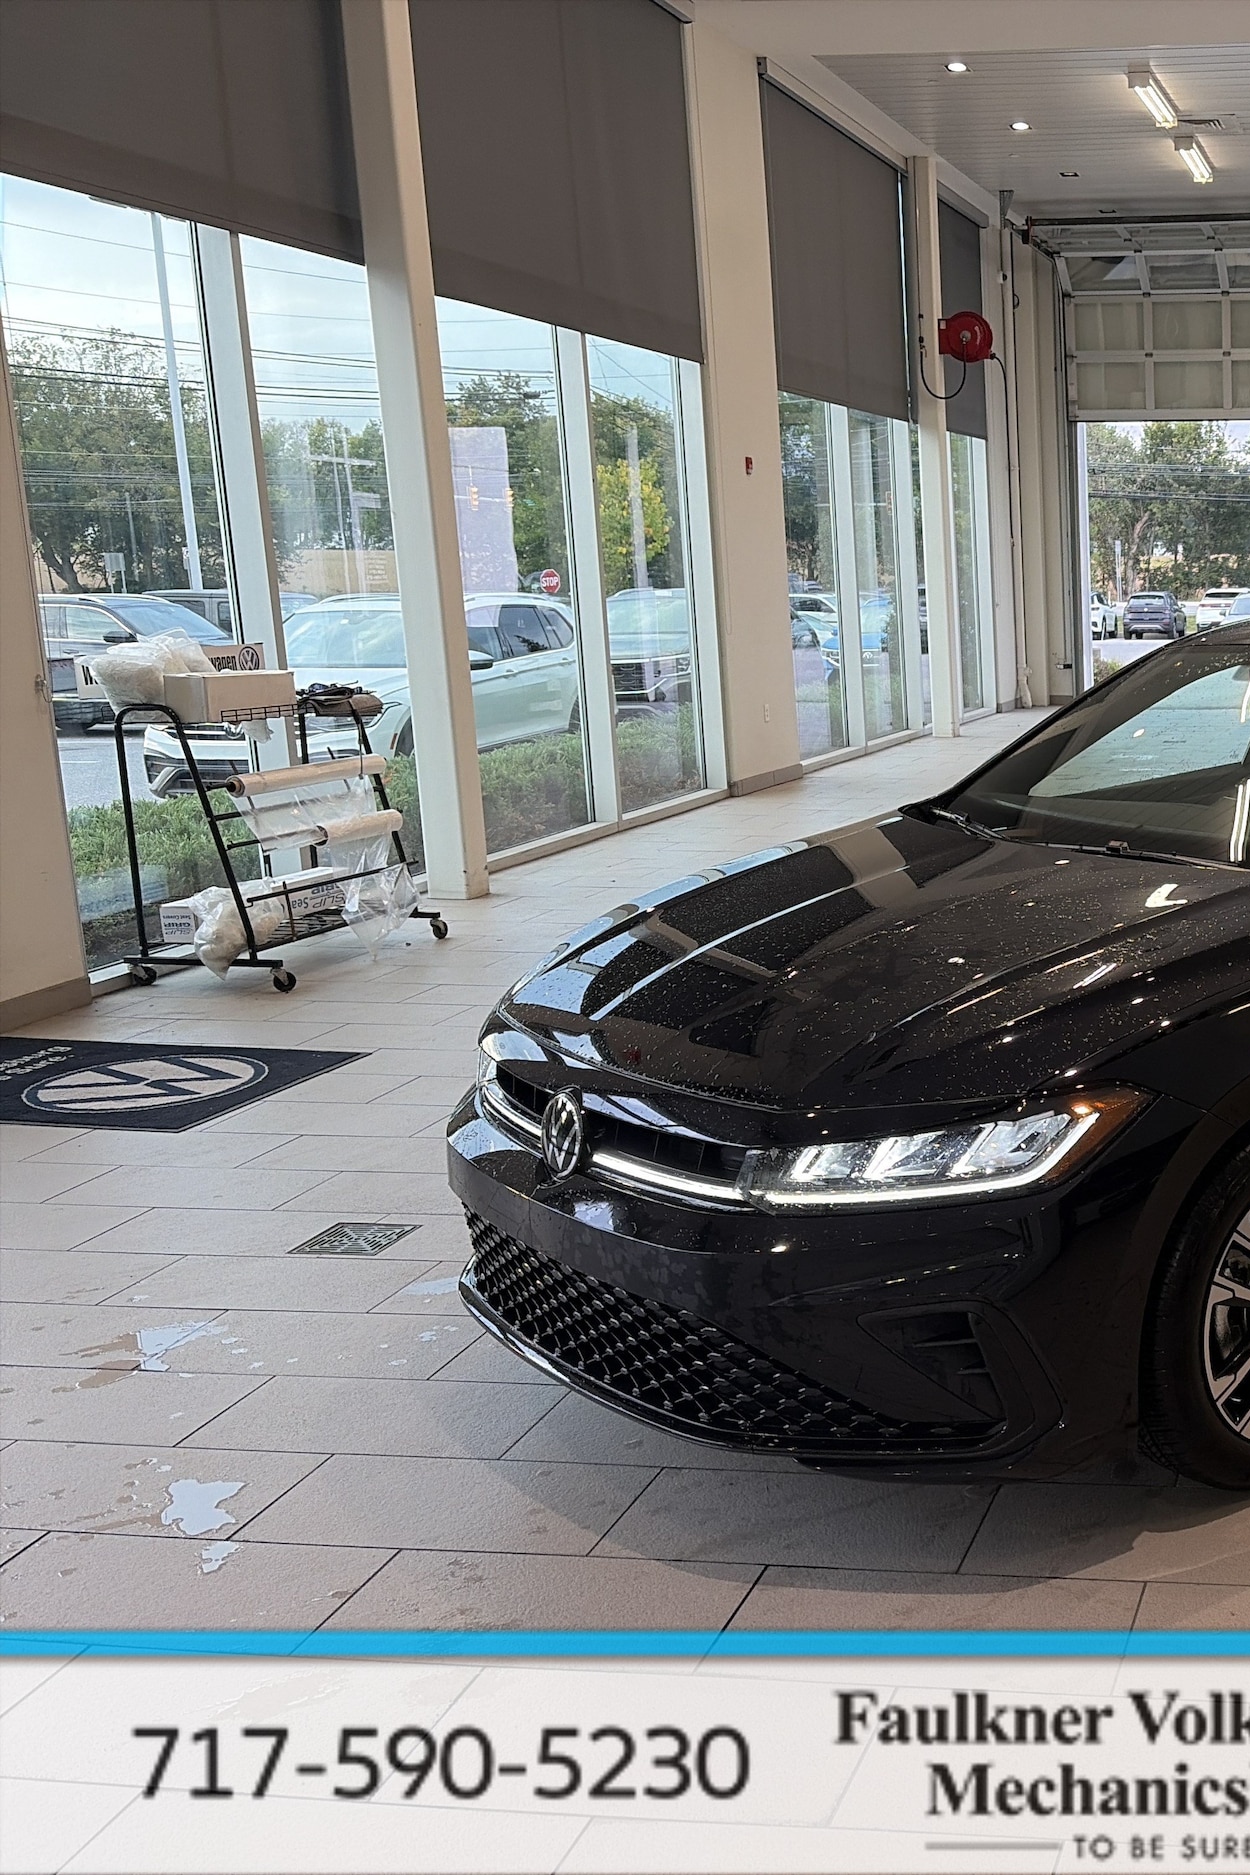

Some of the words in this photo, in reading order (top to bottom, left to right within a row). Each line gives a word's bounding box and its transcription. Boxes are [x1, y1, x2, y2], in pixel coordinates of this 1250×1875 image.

[542, 576, 559, 587] STOP
[208, 655, 238, 672] wagen
[292, 896, 309, 909] Sea
[312, 892, 345, 908] SLIP
